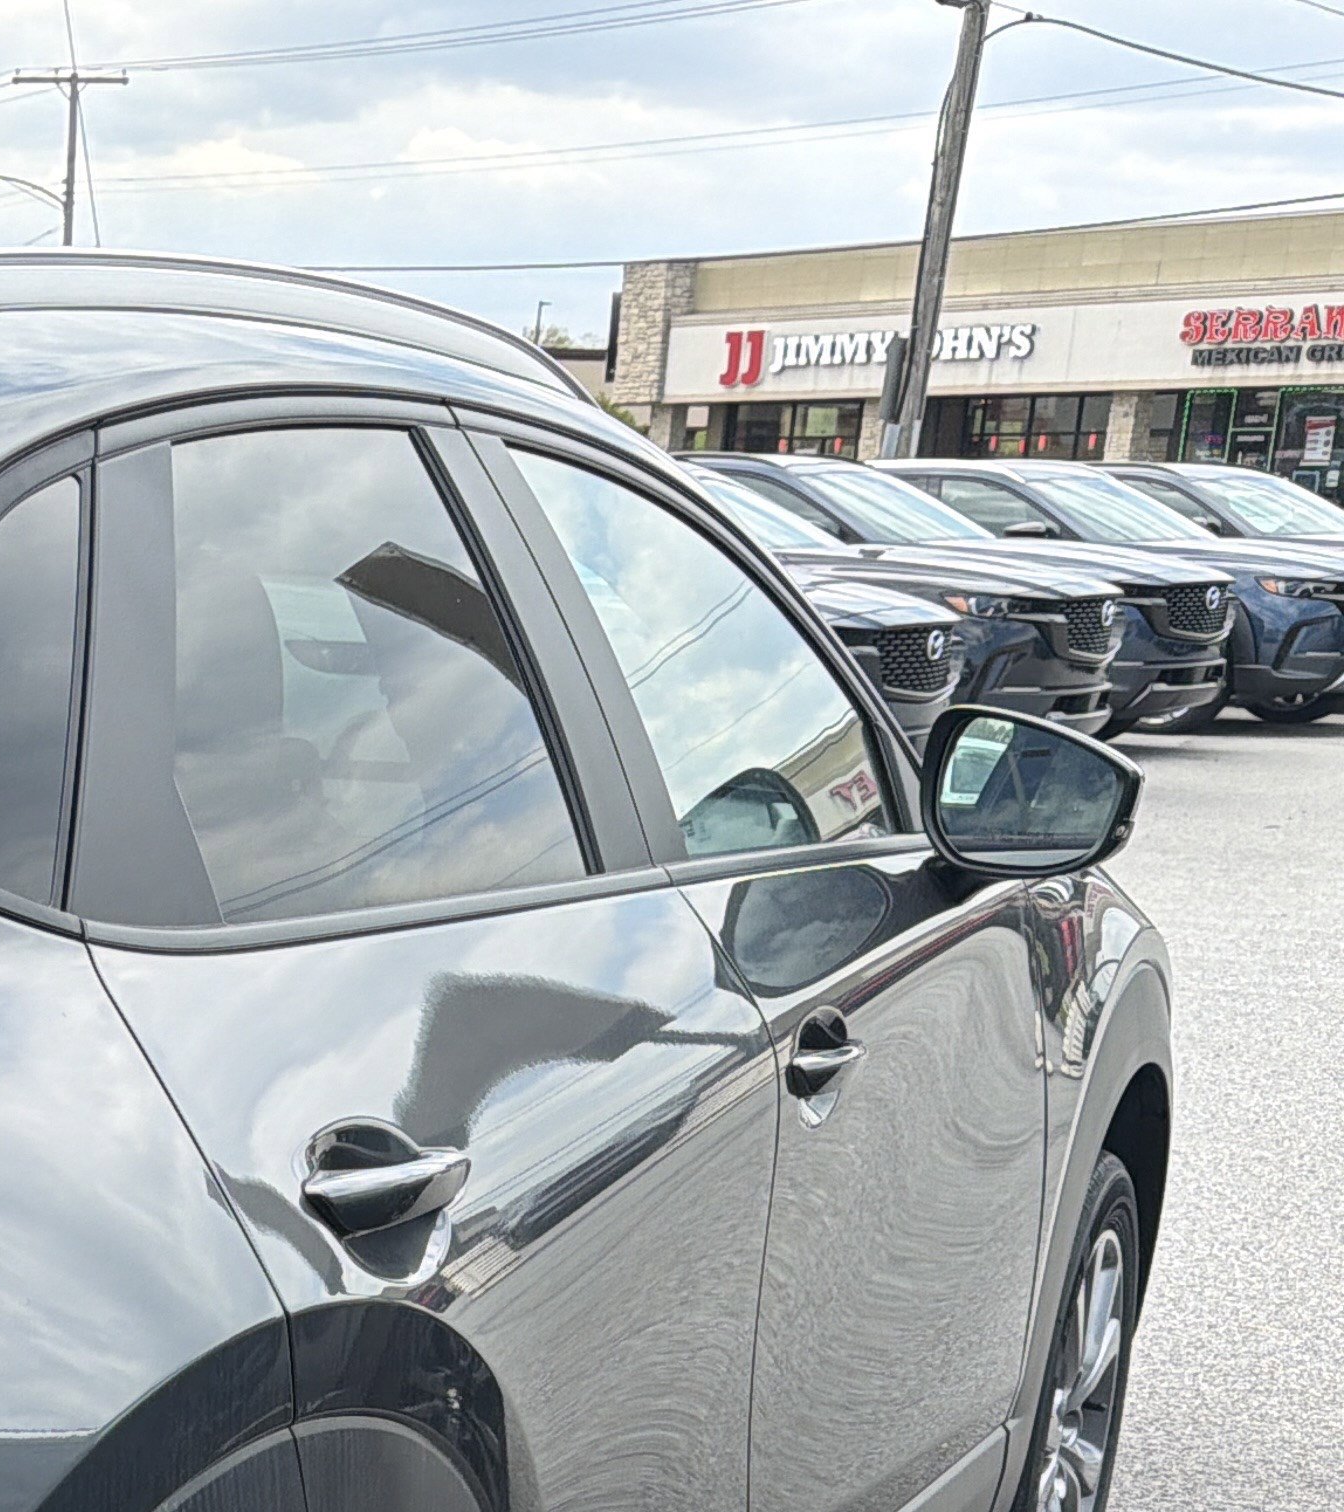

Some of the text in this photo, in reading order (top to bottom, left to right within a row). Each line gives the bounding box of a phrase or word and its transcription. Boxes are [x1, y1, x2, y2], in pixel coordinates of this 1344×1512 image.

[769, 330, 896, 373] JIMMY
[898, 323, 1036, 362] HN'S
[1190, 345, 1303, 366] MEXICAN
